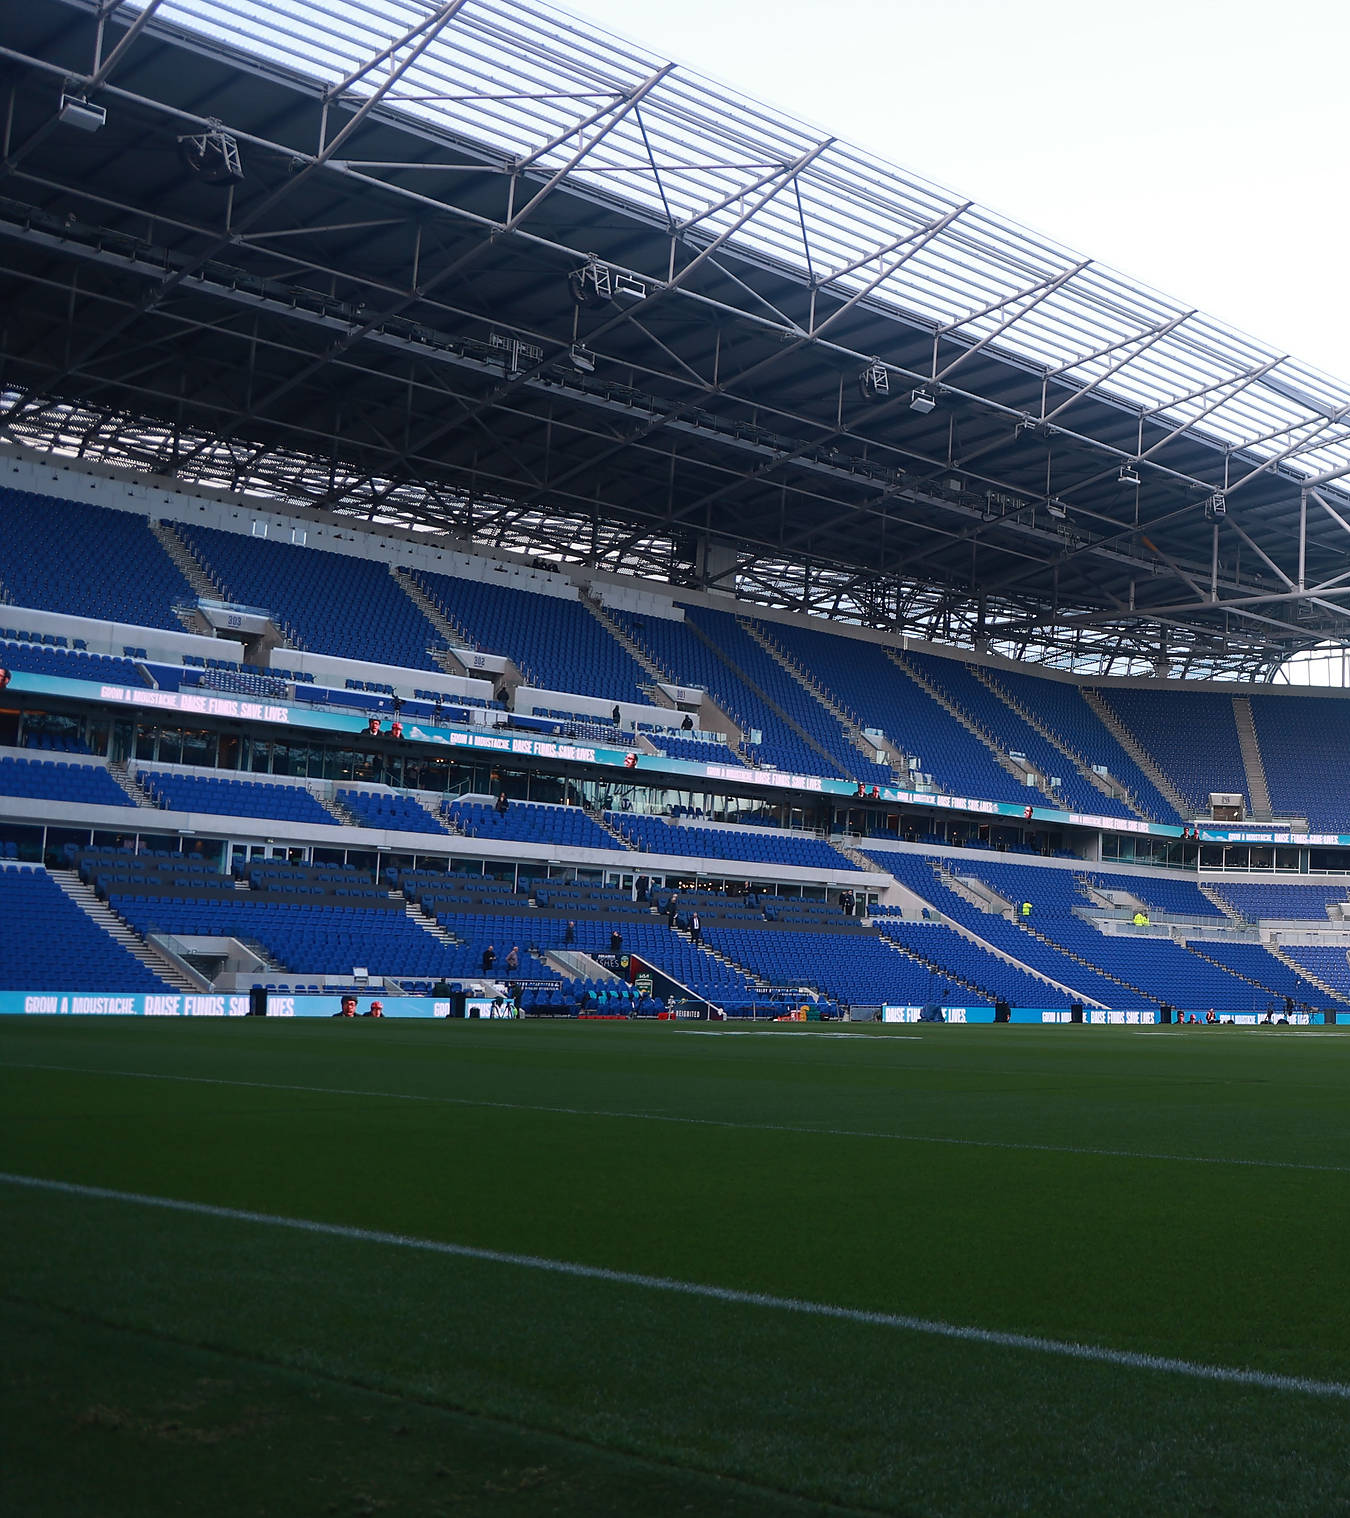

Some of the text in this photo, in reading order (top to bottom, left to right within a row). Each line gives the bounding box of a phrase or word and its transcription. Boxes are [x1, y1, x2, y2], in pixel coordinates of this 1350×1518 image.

[228, 615, 242, 626] 303
[25, 996, 58, 1015] GROW
[61, 997, 69, 1015] A
[144, 996, 180, 1016] RAISE
